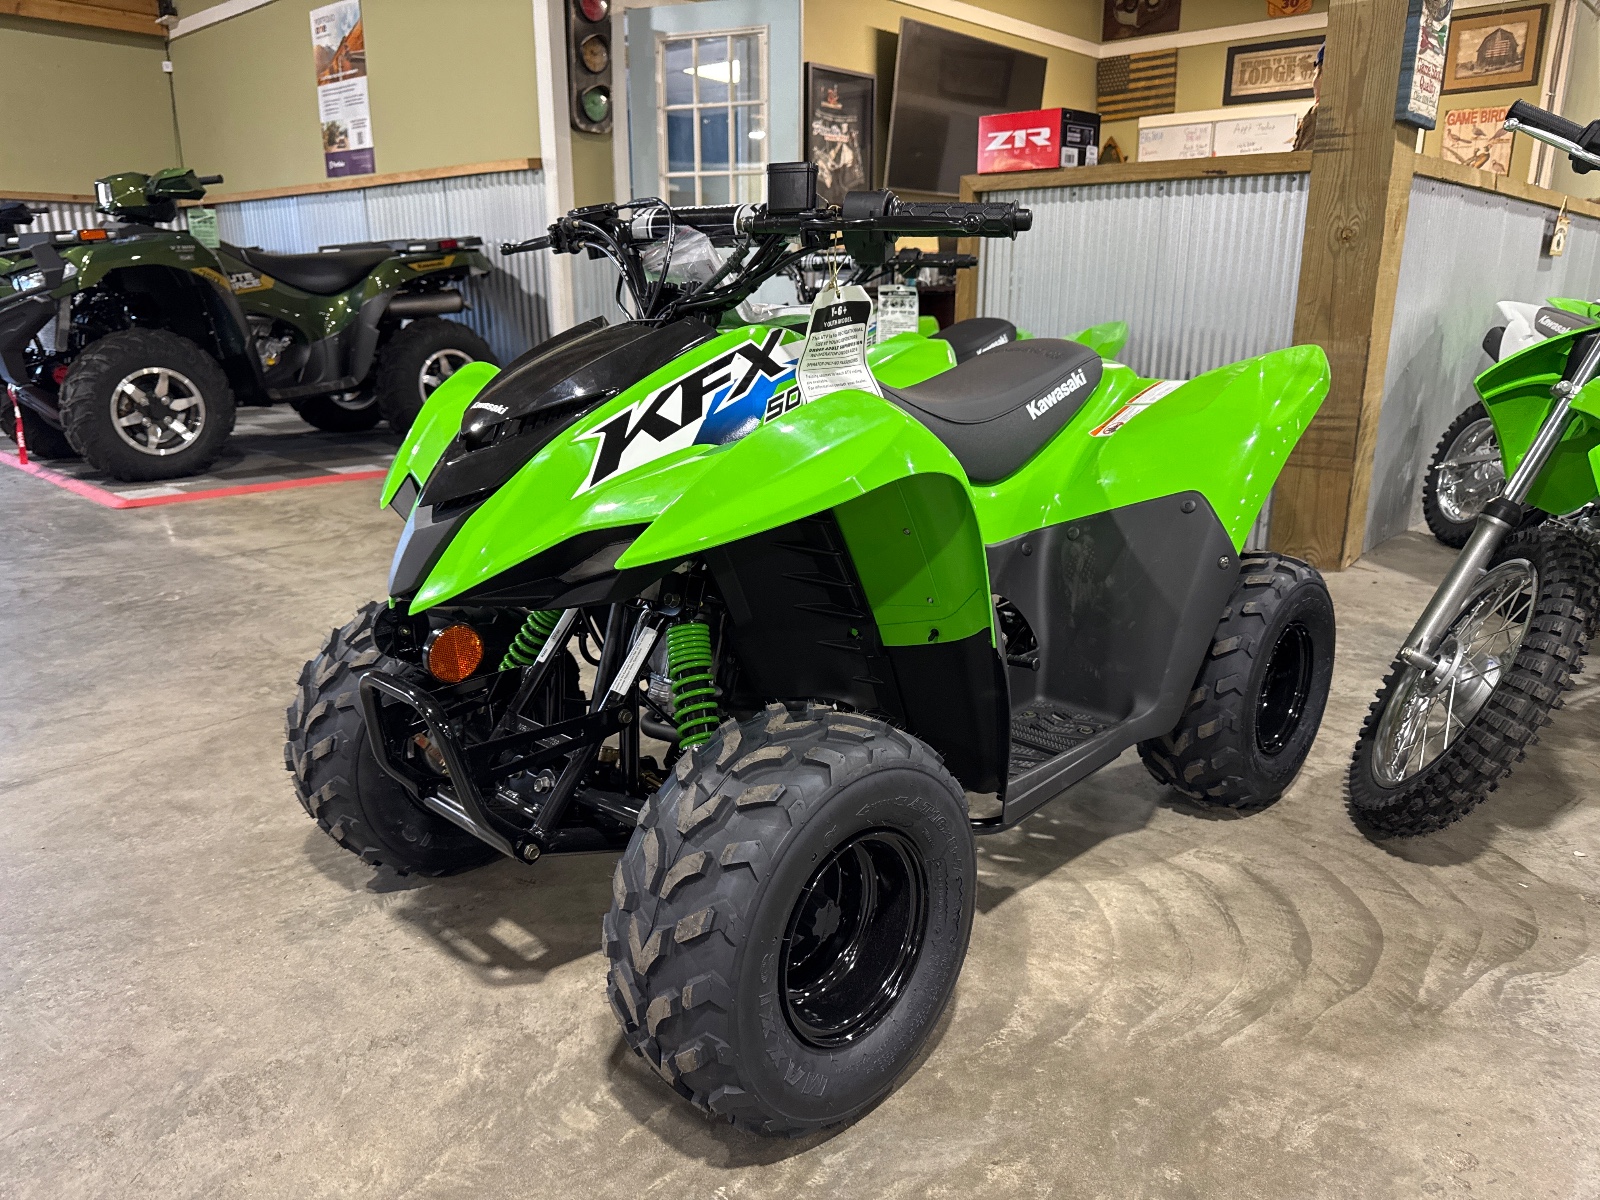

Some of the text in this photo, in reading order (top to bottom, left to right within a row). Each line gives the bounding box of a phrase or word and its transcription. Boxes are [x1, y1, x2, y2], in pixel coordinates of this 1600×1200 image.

[1241, 55, 1297, 69] WELCOME TO THE
[1239, 64, 1296, 87] LODGE
[1447, 108, 1506, 126] GAME BIRD
[985, 127, 1051, 151] Z1R
[983, 146, 1053, 158] HELMETS
[823, 316, 853, 328] YOUTH MODEL
[1538, 315, 1571, 334] Kawasa
[765, 386, 801, 423] 50
[1025, 368, 1087, 420] Kawasaki
[470, 401, 509, 415] Kawasaki
[590, 329, 790, 488] KFX
[759, 953, 828, 1098] MAXXIS
